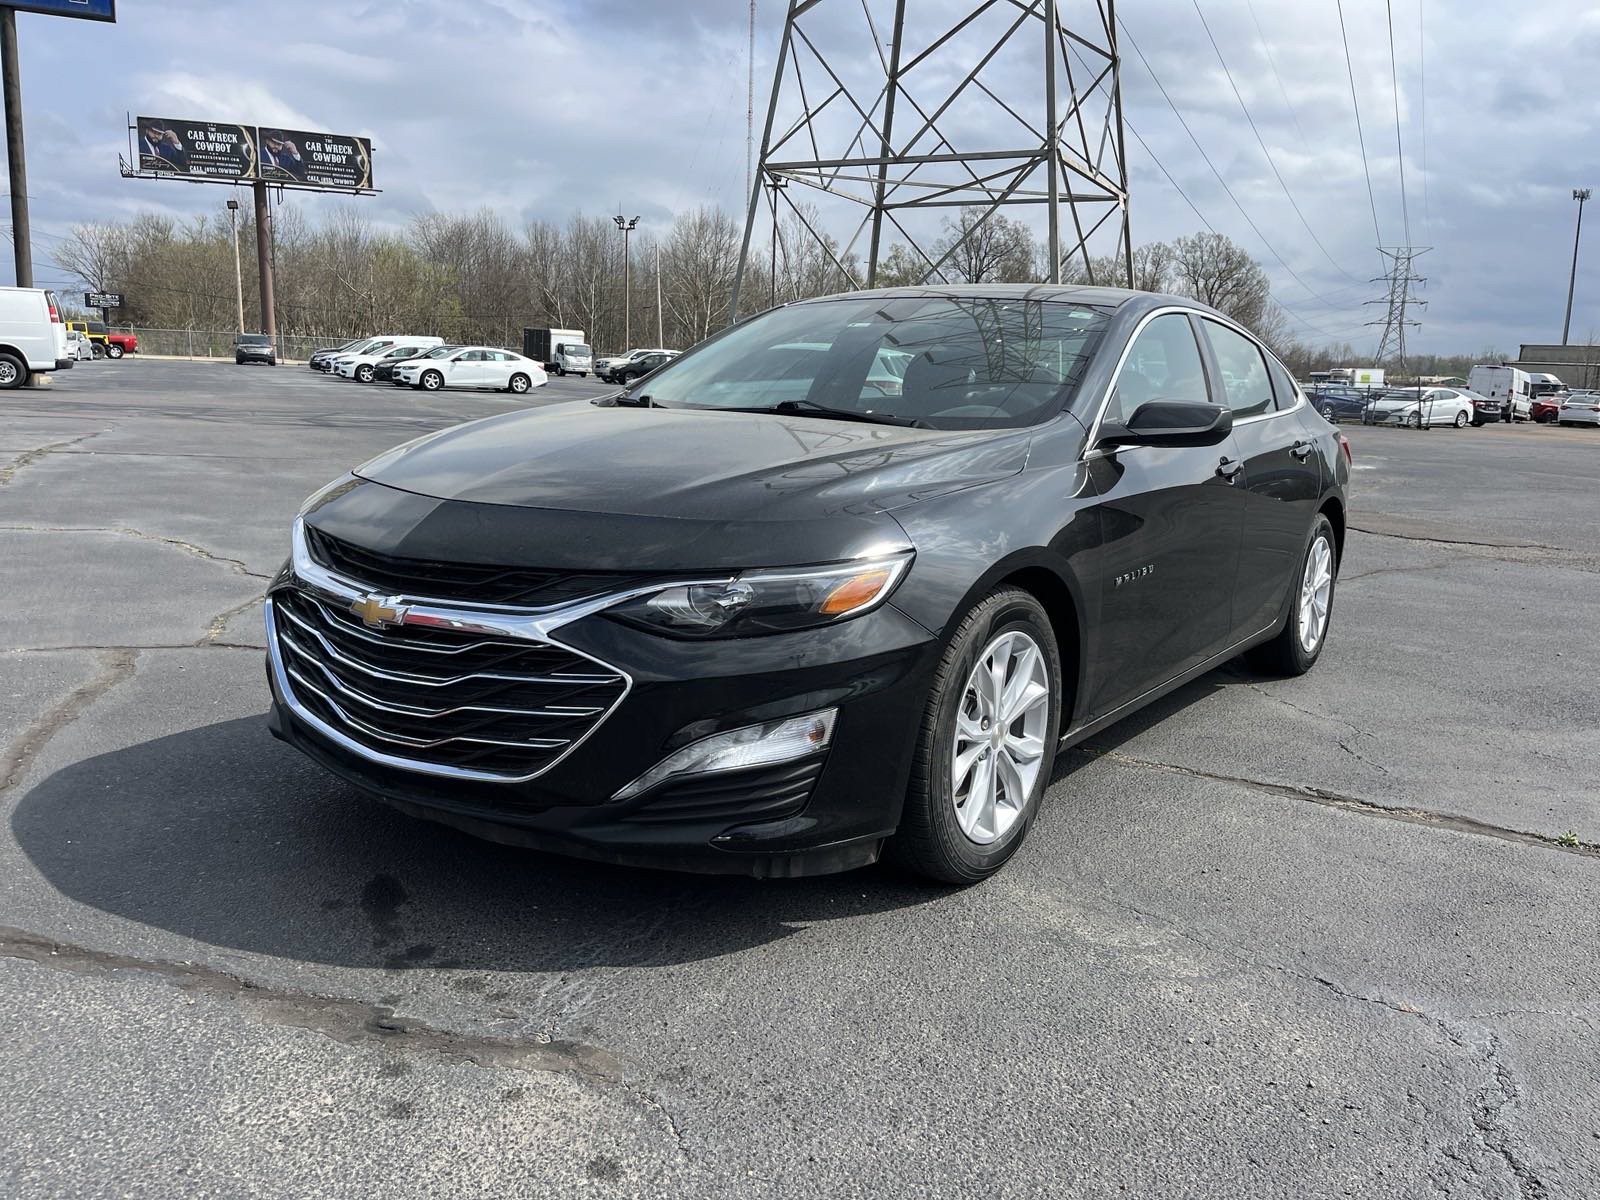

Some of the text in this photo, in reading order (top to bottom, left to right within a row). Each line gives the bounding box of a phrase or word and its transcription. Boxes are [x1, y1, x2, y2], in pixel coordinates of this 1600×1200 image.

[188, 130, 238, 144] CAR WRECK
[196, 142, 231, 153] COWBOY
[306, 141, 353, 155] CAR WRECK
[313, 152, 346, 164] COWBOY
[1115, 564, 1154, 588] MALIBU
